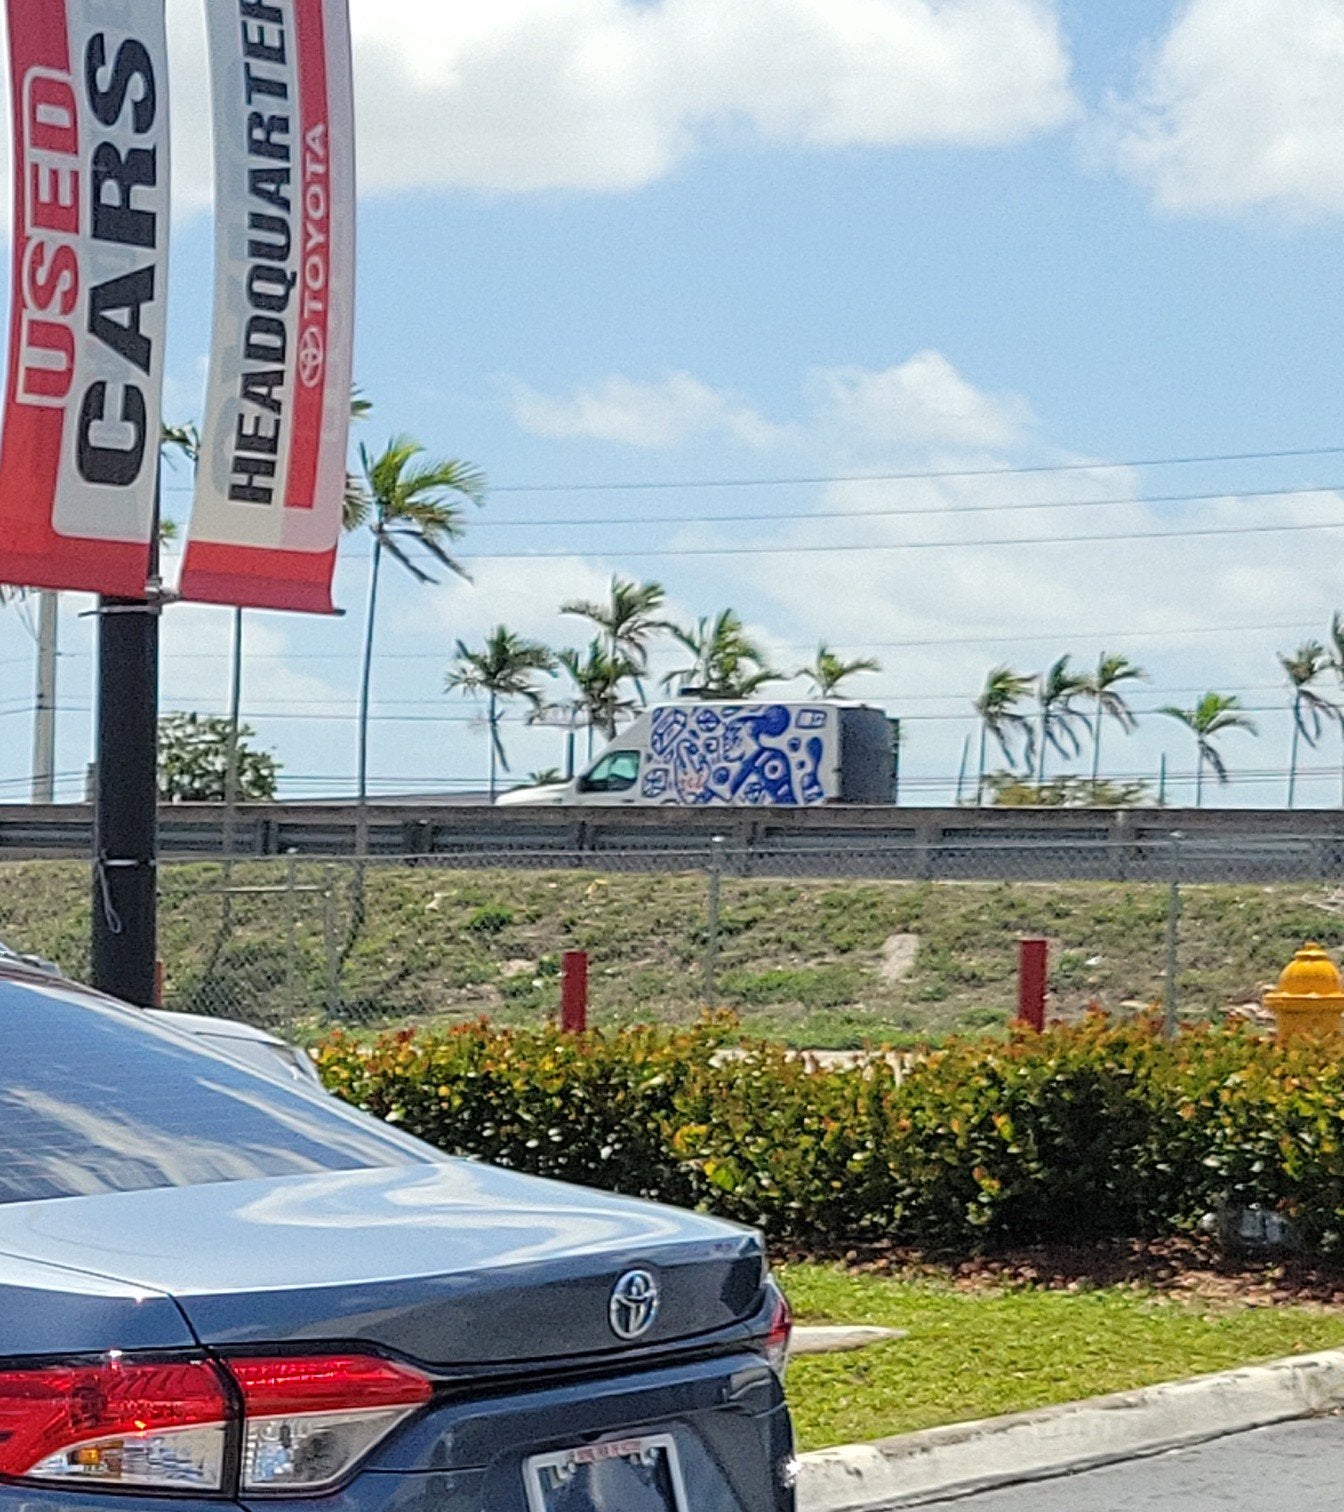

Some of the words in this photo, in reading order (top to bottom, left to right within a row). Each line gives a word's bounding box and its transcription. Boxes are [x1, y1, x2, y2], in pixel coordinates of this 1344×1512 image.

[16, 67, 80, 405] USED
[76, 32, 157, 488] CARS
[304, 122, 327, 319] TOYOTA
